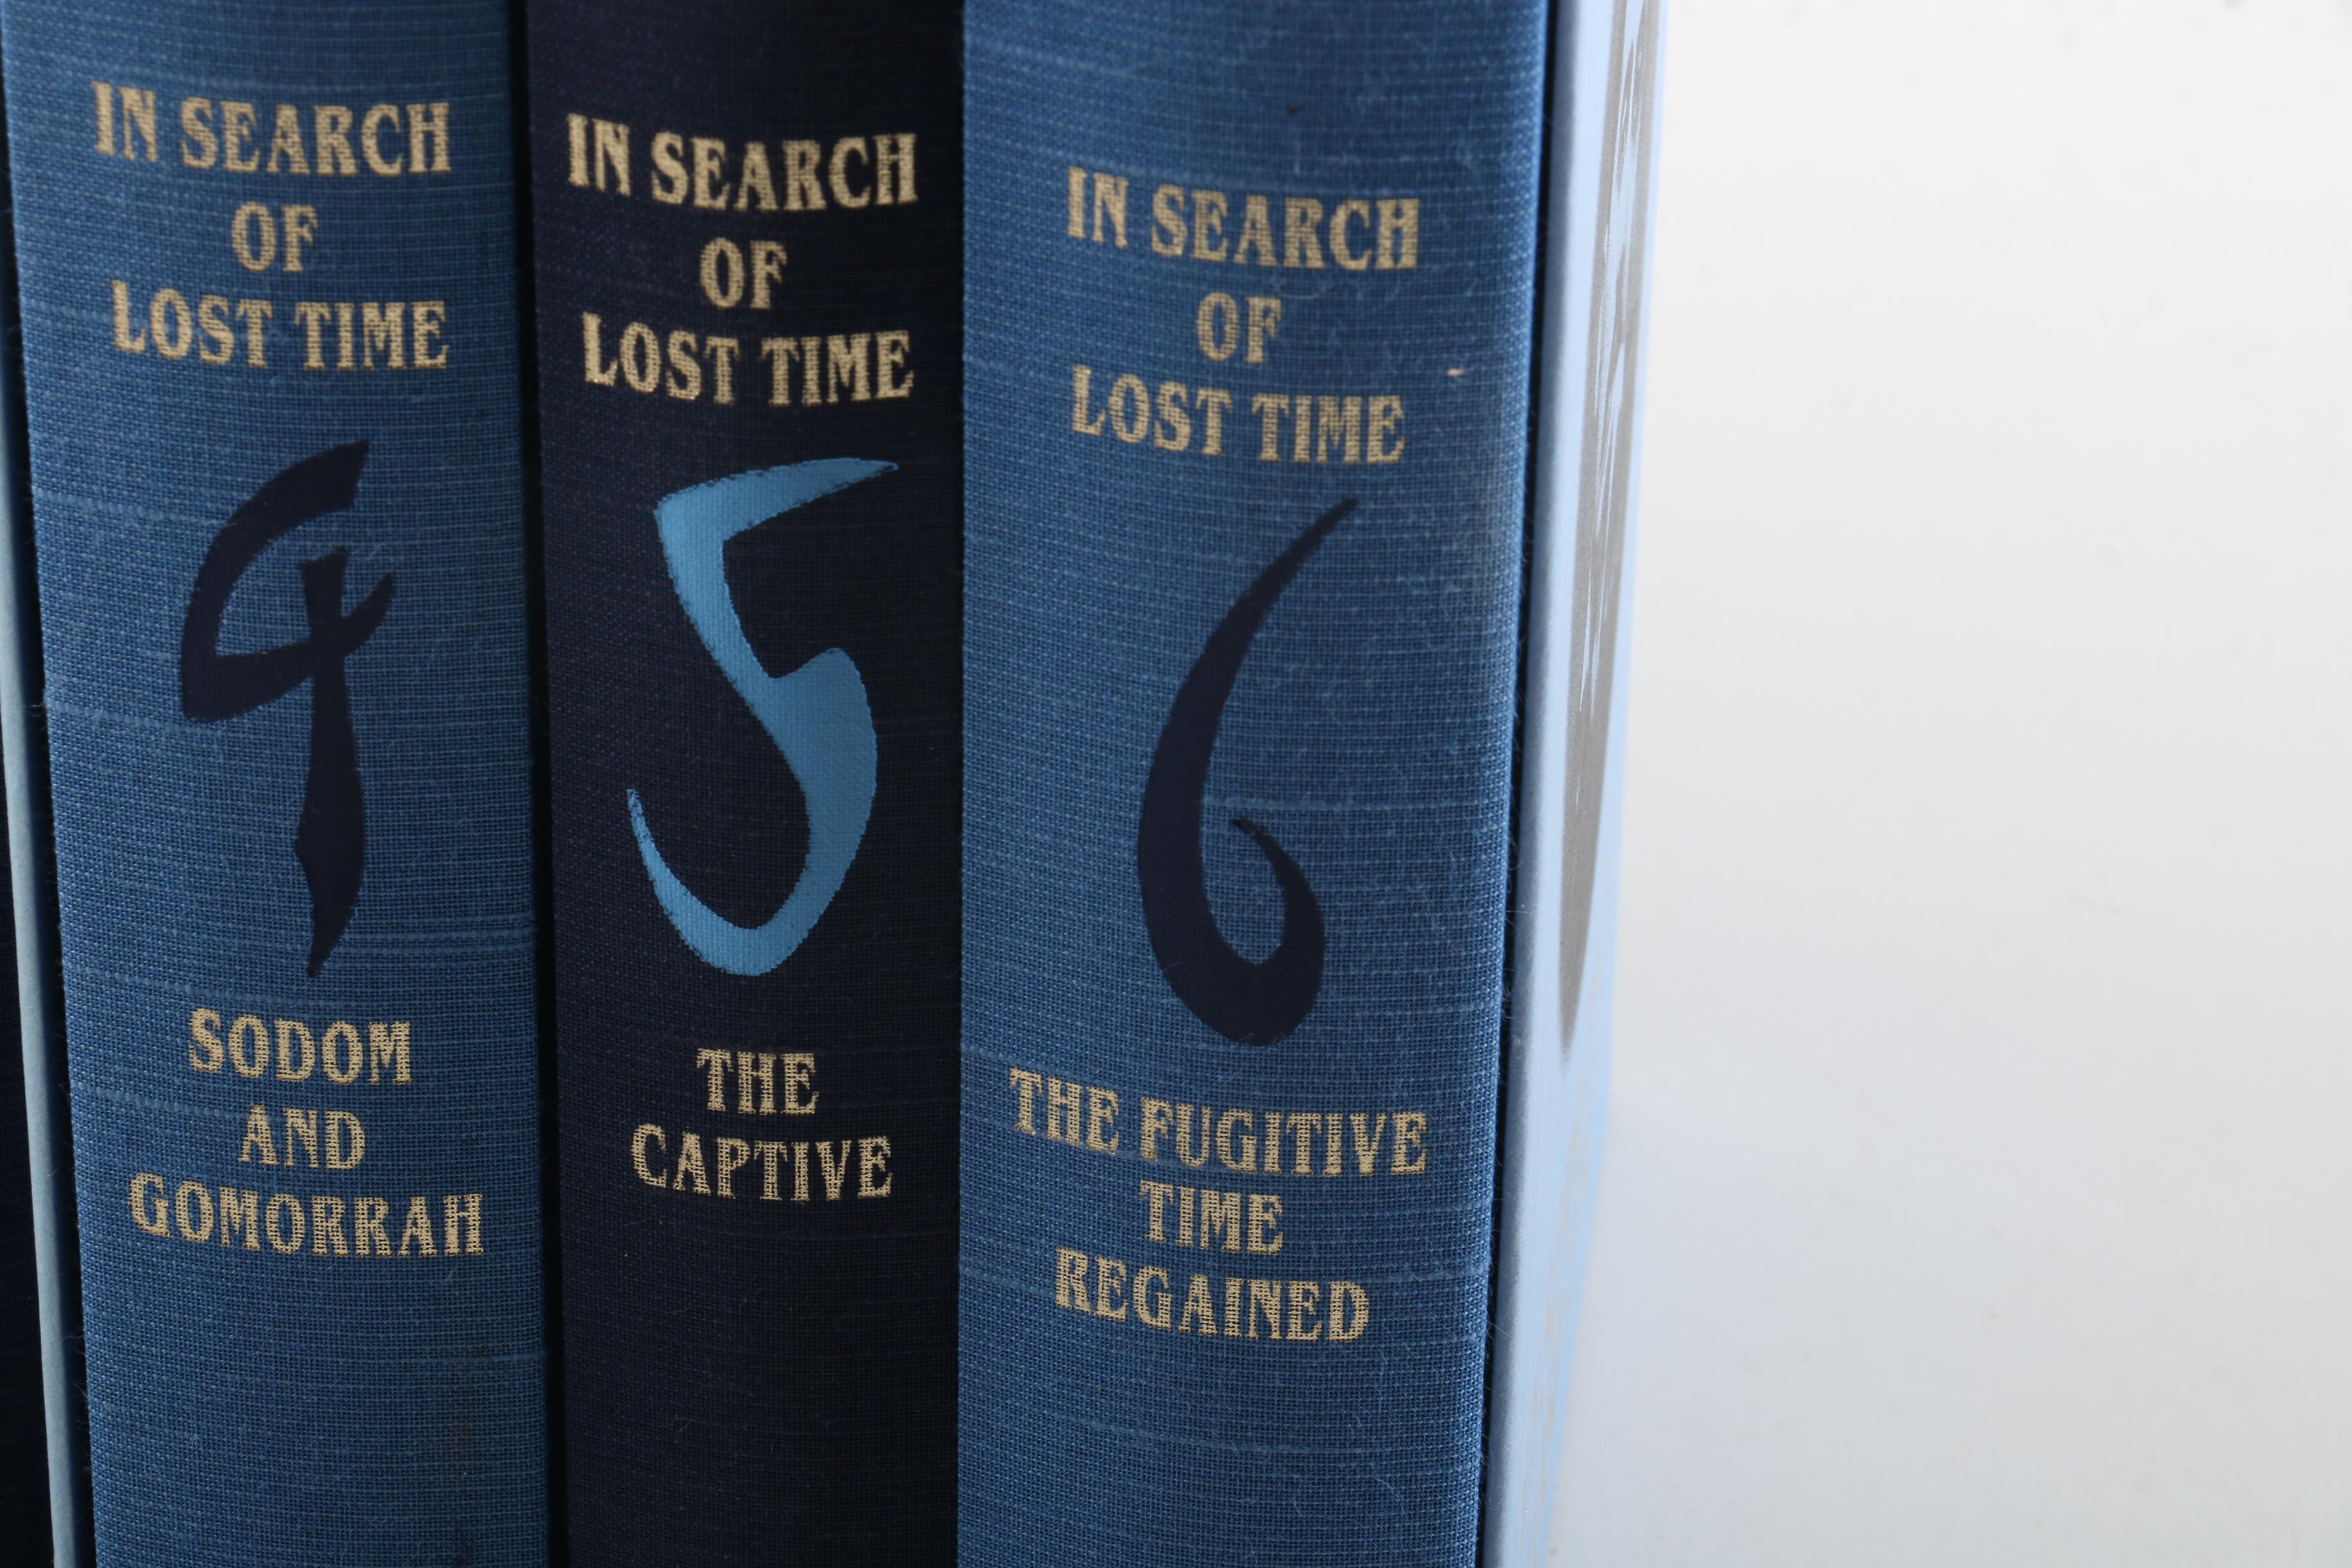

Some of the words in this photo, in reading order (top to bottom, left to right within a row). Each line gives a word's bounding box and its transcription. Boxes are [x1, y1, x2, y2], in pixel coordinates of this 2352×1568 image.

[93, 82, 157, 162] IN
[181, 97, 450, 175] SEARCH
[568, 114, 630, 195] IN
[652, 132, 916, 210] SEARCH
[231, 202, 317, 271] OF
[1067, 167, 1128, 248] IN
[1152, 185, 1418, 270] SEARCH
[701, 238, 786, 308] OF
[112, 280, 271, 367] LOST
[295, 302, 448, 369] TIME
[583, 313, 738, 403] LOST
[762, 331, 913, 404] TIME
[1197, 293, 1280, 362] OF
[1072, 366, 1231, 455] LOST
[1252, 394, 1404, 464] TIME
[181, 441, 396, 978] 4
[626, 457, 899, 975] 5
[1137, 498, 1360, 1046] 6
[190, 1008, 411, 1084] SODOM
[697, 1048, 818, 1114] THE
[239, 1105, 366, 1169] AND
[632, 1124, 892, 1202] CAPTIVE
[1010, 1068, 1119, 1155] THE
[1141, 1097, 1426, 1176] FUGITIVE
[129, 1173, 484, 1256] GOMORRAH
[1141, 1181, 1282, 1254] TIME
[1056, 1246, 1368, 1340] REGAINED
